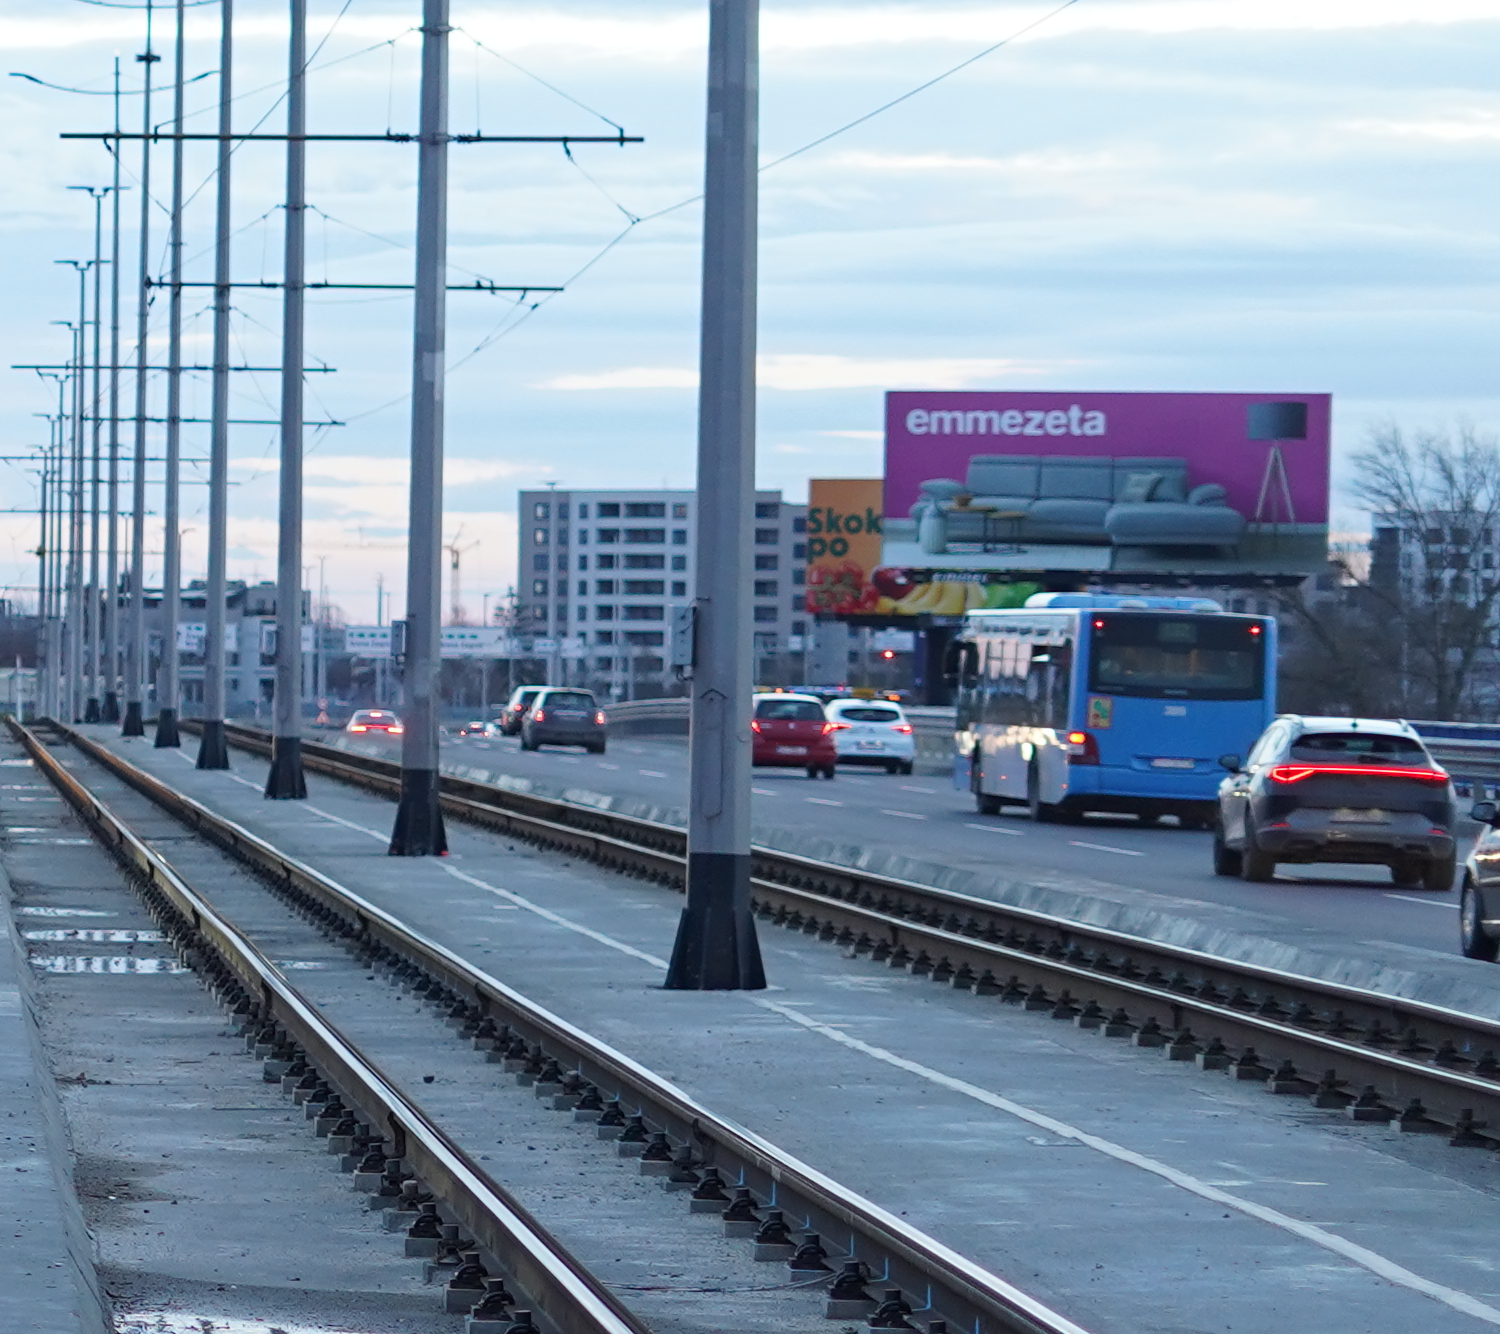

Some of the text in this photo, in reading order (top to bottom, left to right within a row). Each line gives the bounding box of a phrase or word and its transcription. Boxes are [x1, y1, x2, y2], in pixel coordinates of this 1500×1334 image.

[906, 405, 1106, 436] emmezeta
[808, 507, 882, 534] Skok
[808, 537, 849, 563] po
